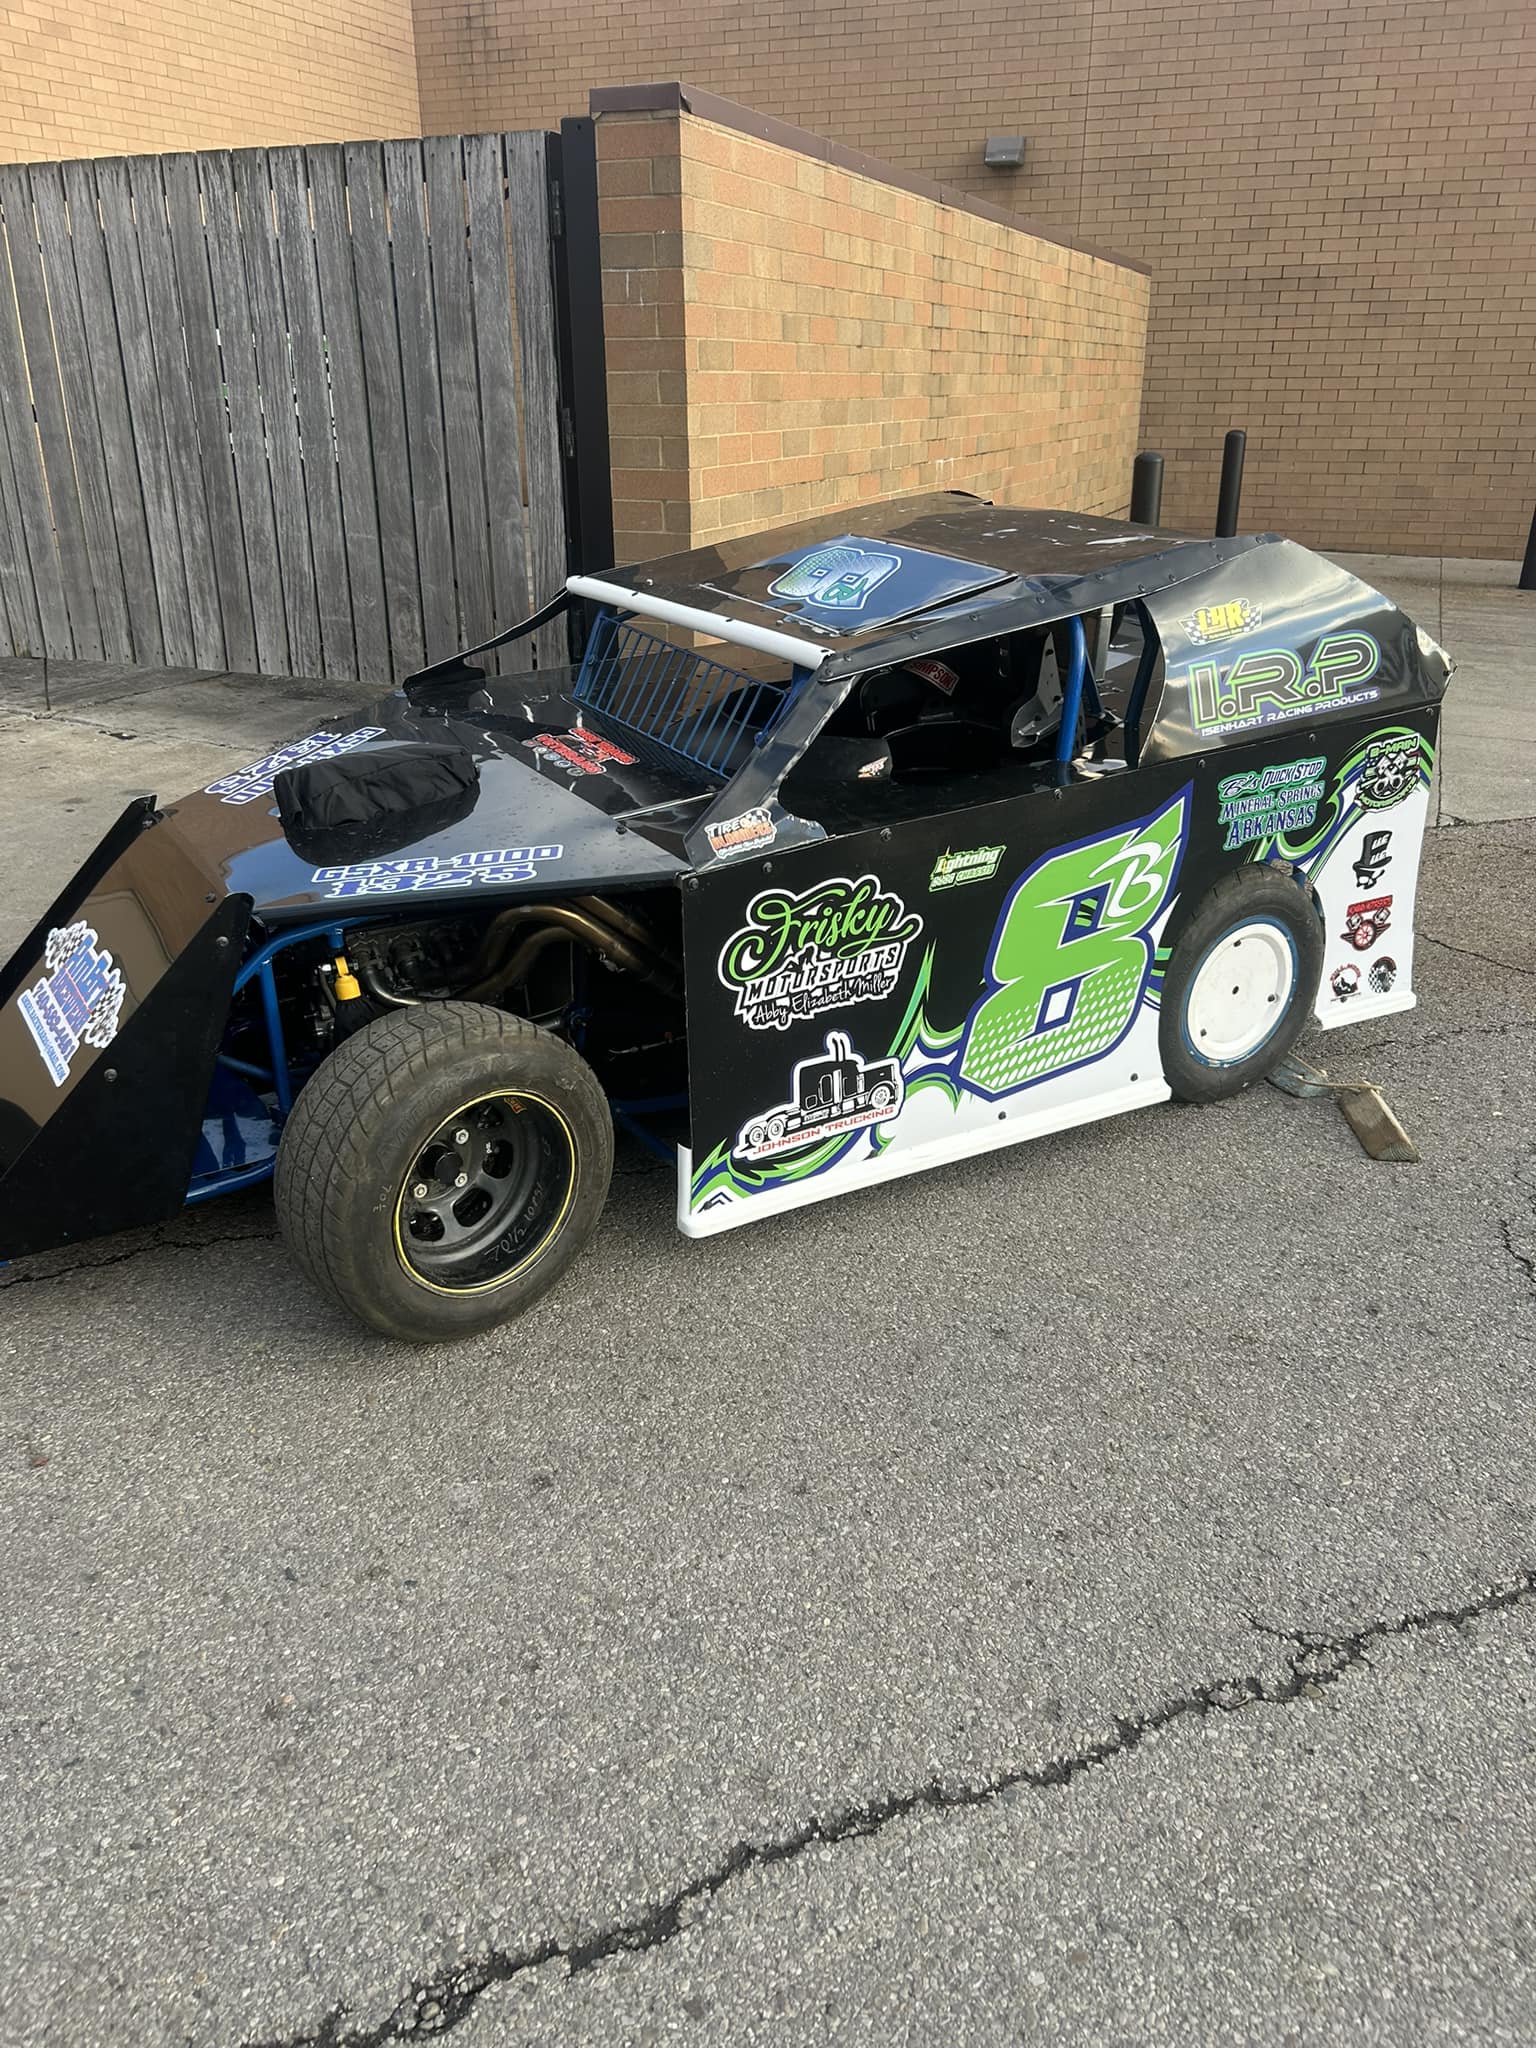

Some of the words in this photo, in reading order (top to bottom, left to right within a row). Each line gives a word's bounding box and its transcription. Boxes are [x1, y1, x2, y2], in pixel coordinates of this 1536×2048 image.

[909, 660, 956, 690] SIMPSON
[1201, 715, 1264, 737] ISENHART
[1266, 704, 1314, 724] RACING
[1314, 690, 1379, 712] PRODUCTS
[1261, 768, 1294, 792] QUICK
[1294, 760, 1323, 781] STOP
[1222, 794, 1273, 819] MINERAL
[1278, 783, 1322, 808] SPRINGS
[1227, 804, 1315, 847] ARKANSAS
[315, 846, 562, 881] GSXR-1000
[934, 848, 1002, 876] Lightning
[728, 885, 914, 981] Frisky
[746, 946, 899, 1004] MOTORSPORTS
[753, 1003, 789, 1025] Abby
[791, 984, 852, 1012] Elizabeth
[852, 973, 894, 997] Miller
[752, 1129, 821, 1155] JOHNSON
[824, 1107, 895, 1132] TRUCKING
